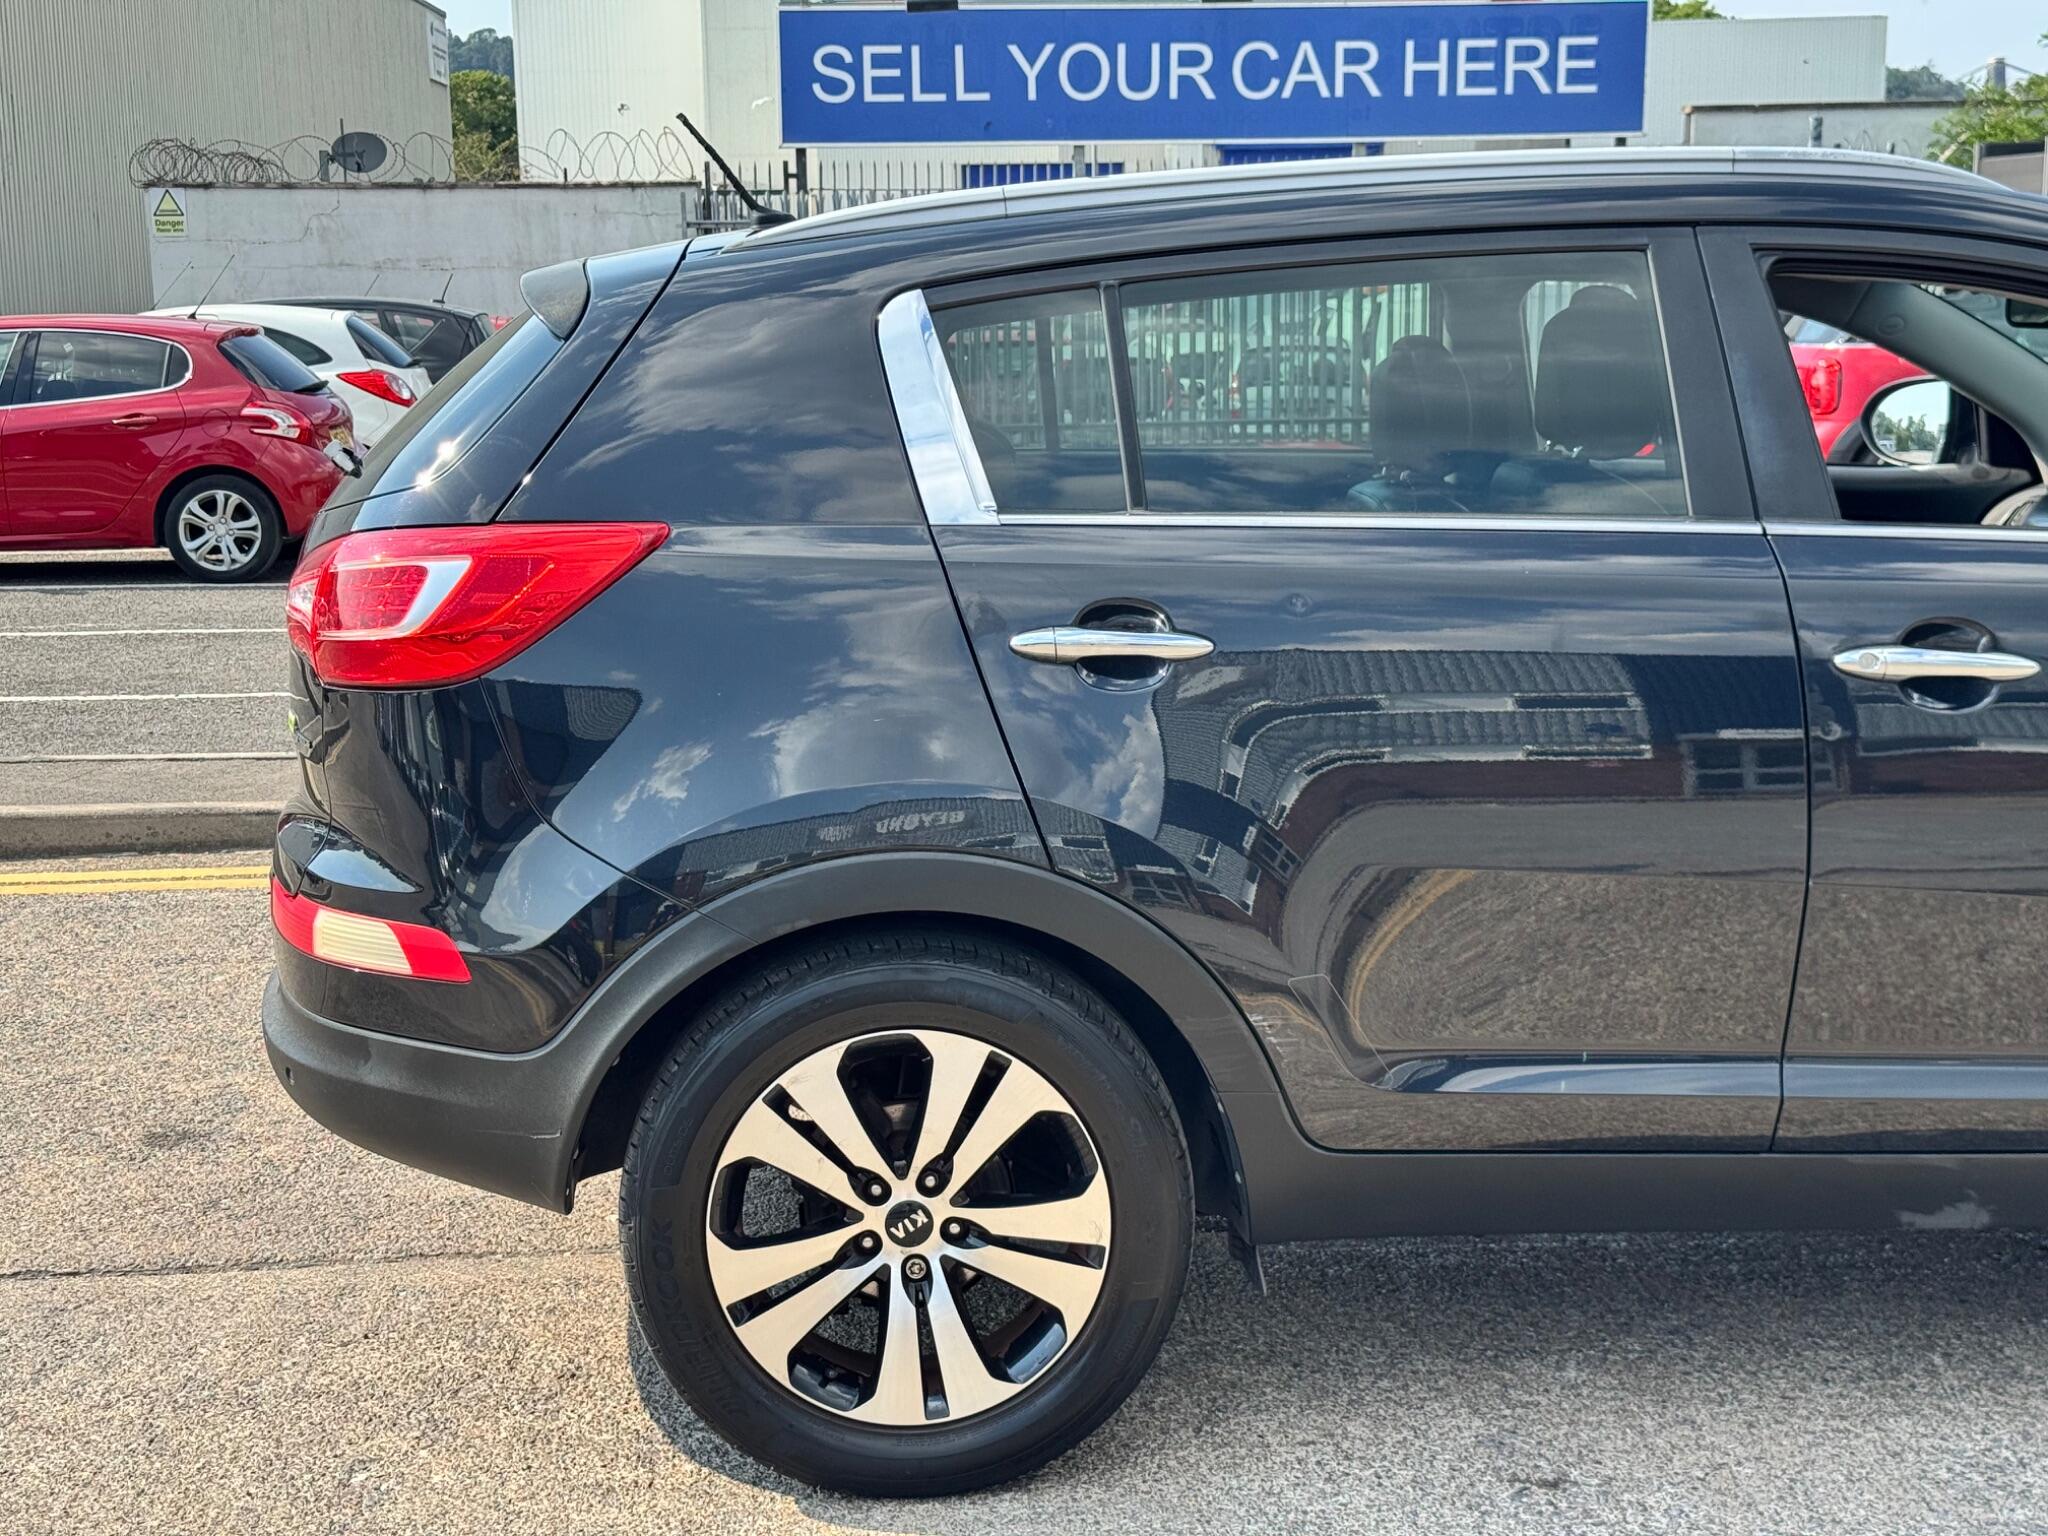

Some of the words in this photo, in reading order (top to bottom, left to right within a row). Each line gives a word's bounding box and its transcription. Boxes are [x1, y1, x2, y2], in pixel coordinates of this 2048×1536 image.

[812, 45, 991, 103] SELL
[1007, 42, 1216, 101] YOUR
[1232, 40, 1381, 99] CAR
[1404, 36, 1598, 97] HERE
[154, 218, 185, 228] Danger
[889, 1208, 929, 1239] KIA
